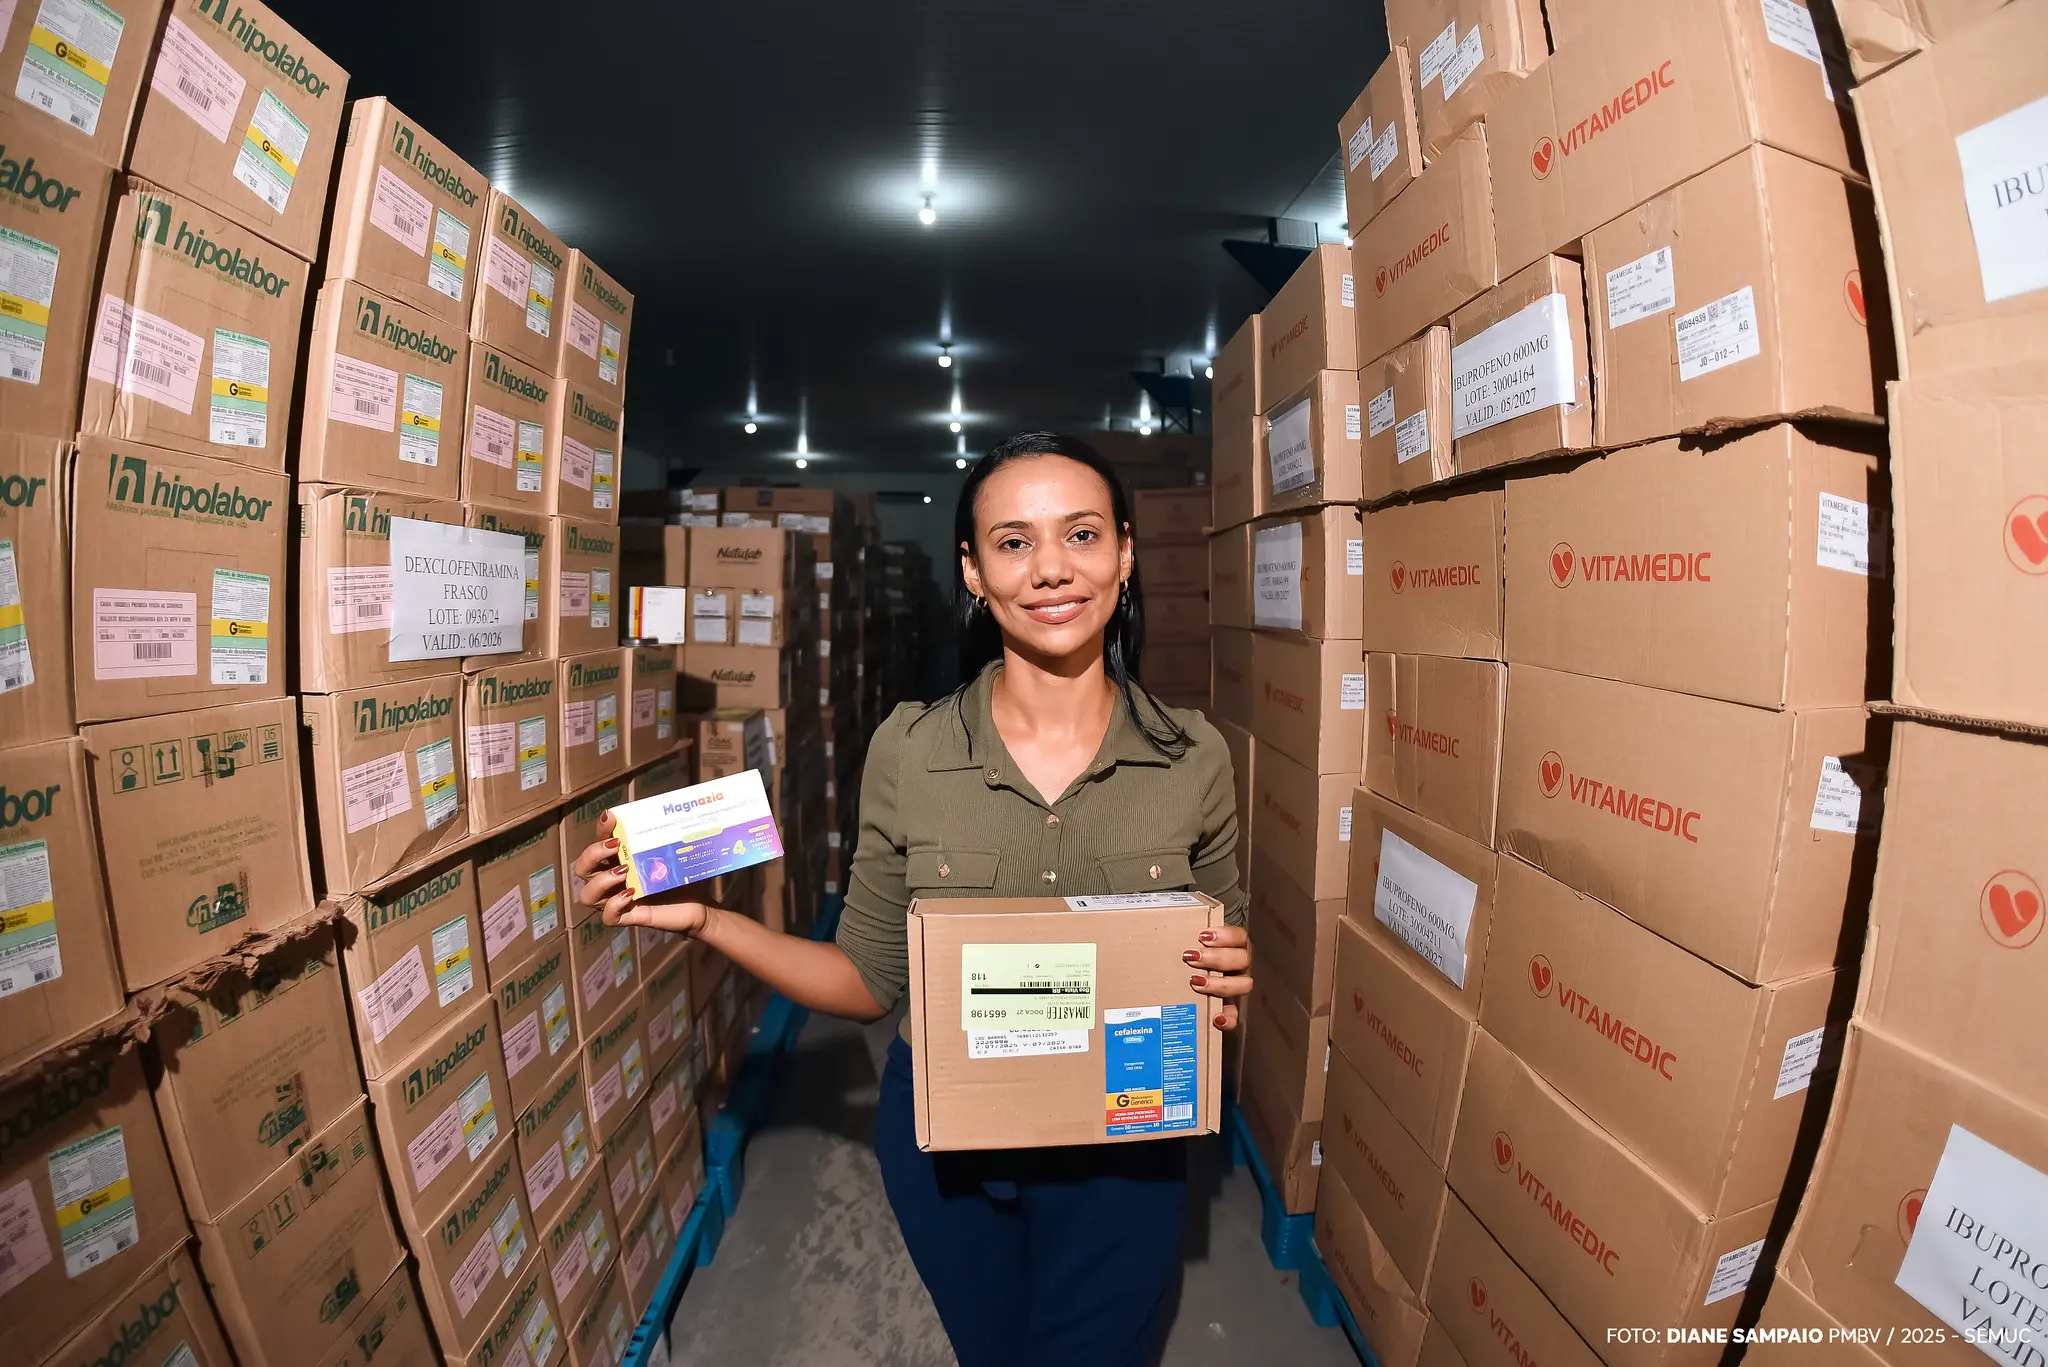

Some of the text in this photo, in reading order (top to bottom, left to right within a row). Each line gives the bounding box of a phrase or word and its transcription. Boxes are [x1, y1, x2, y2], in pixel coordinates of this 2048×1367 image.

[227, 7, 329, 99] hipolabor
[1558, 60, 1675, 157] VITAMEDIC
[412, 144, 479, 208] hipolabor
[1993, 163, 2048, 208] IBU
[173, 221, 290, 298] hipolabor
[518, 222, 563, 270] hipolabor
[1388, 223, 1449, 283] VITAMEDIC
[1609, 263, 1642, 282] VITAMEDIC AG
[592, 278, 628, 314] hipolabor
[381, 315, 457, 365] hipolabor
[1738, 320, 1749, 333] AG
[499, 365, 549, 403] hipolabor
[1453, 334, 1549, 392] IBUPROFENO 600MG
[1464, 364, 1535, 407] LOTE: 30004164
[1465, 387, 1537, 428] VALID.: 05/2027
[151, 471, 272, 522] hipolabor
[1822, 499, 1858, 515] VITAMEDIC AG
[405, 555, 519, 580] DEXCLOFENIRAMINA
[717, 547, 762, 559] Natulab
[1581, 552, 1711, 582] VITAMEDIC
[444, 584, 488, 601] FRASCO
[1409, 565, 1480, 588] VITAMEDIC
[429, 609, 463, 625] LOTE:
[422, 631, 502, 651] VALID.: 06/2026
[499, 678, 553, 707] hipolabor
[264, 729, 276, 741] 05
[380, 695, 453, 733] hipolabor
[1399, 722, 1459, 758] VITAMEDIC
[662, 791, 724, 815] Magnazia
[1569, 773, 1700, 843] VITAMEDIC
[1382, 875, 1455, 940] IBUPROFENO 600MG
[1388, 899, 1442, 950] LOTE: 30004211
[1387, 915, 1444, 968] VALID.: 05/2027
[518, 952, 562, 996] hipolabor
[971, 1009, 1007, 1018] 665198
[1114, 1027, 1153, 1036] cefalexina
[1558, 981, 1677, 1081] VITAMEDIC
[425, 1023, 487, 1090] hipolabor
[1366, 1006, 1423, 1077] VITAMEDIC
[1116, 1094, 1130, 1107] G
[1131, 1098, 1153, 1106] Genérico
[461, 1156, 511, 1225] hipolabor
[1354, 1132, 1405, 1210] VITAMEDIC
[1516, 1162, 1620, 1277] VITAMEDIC
